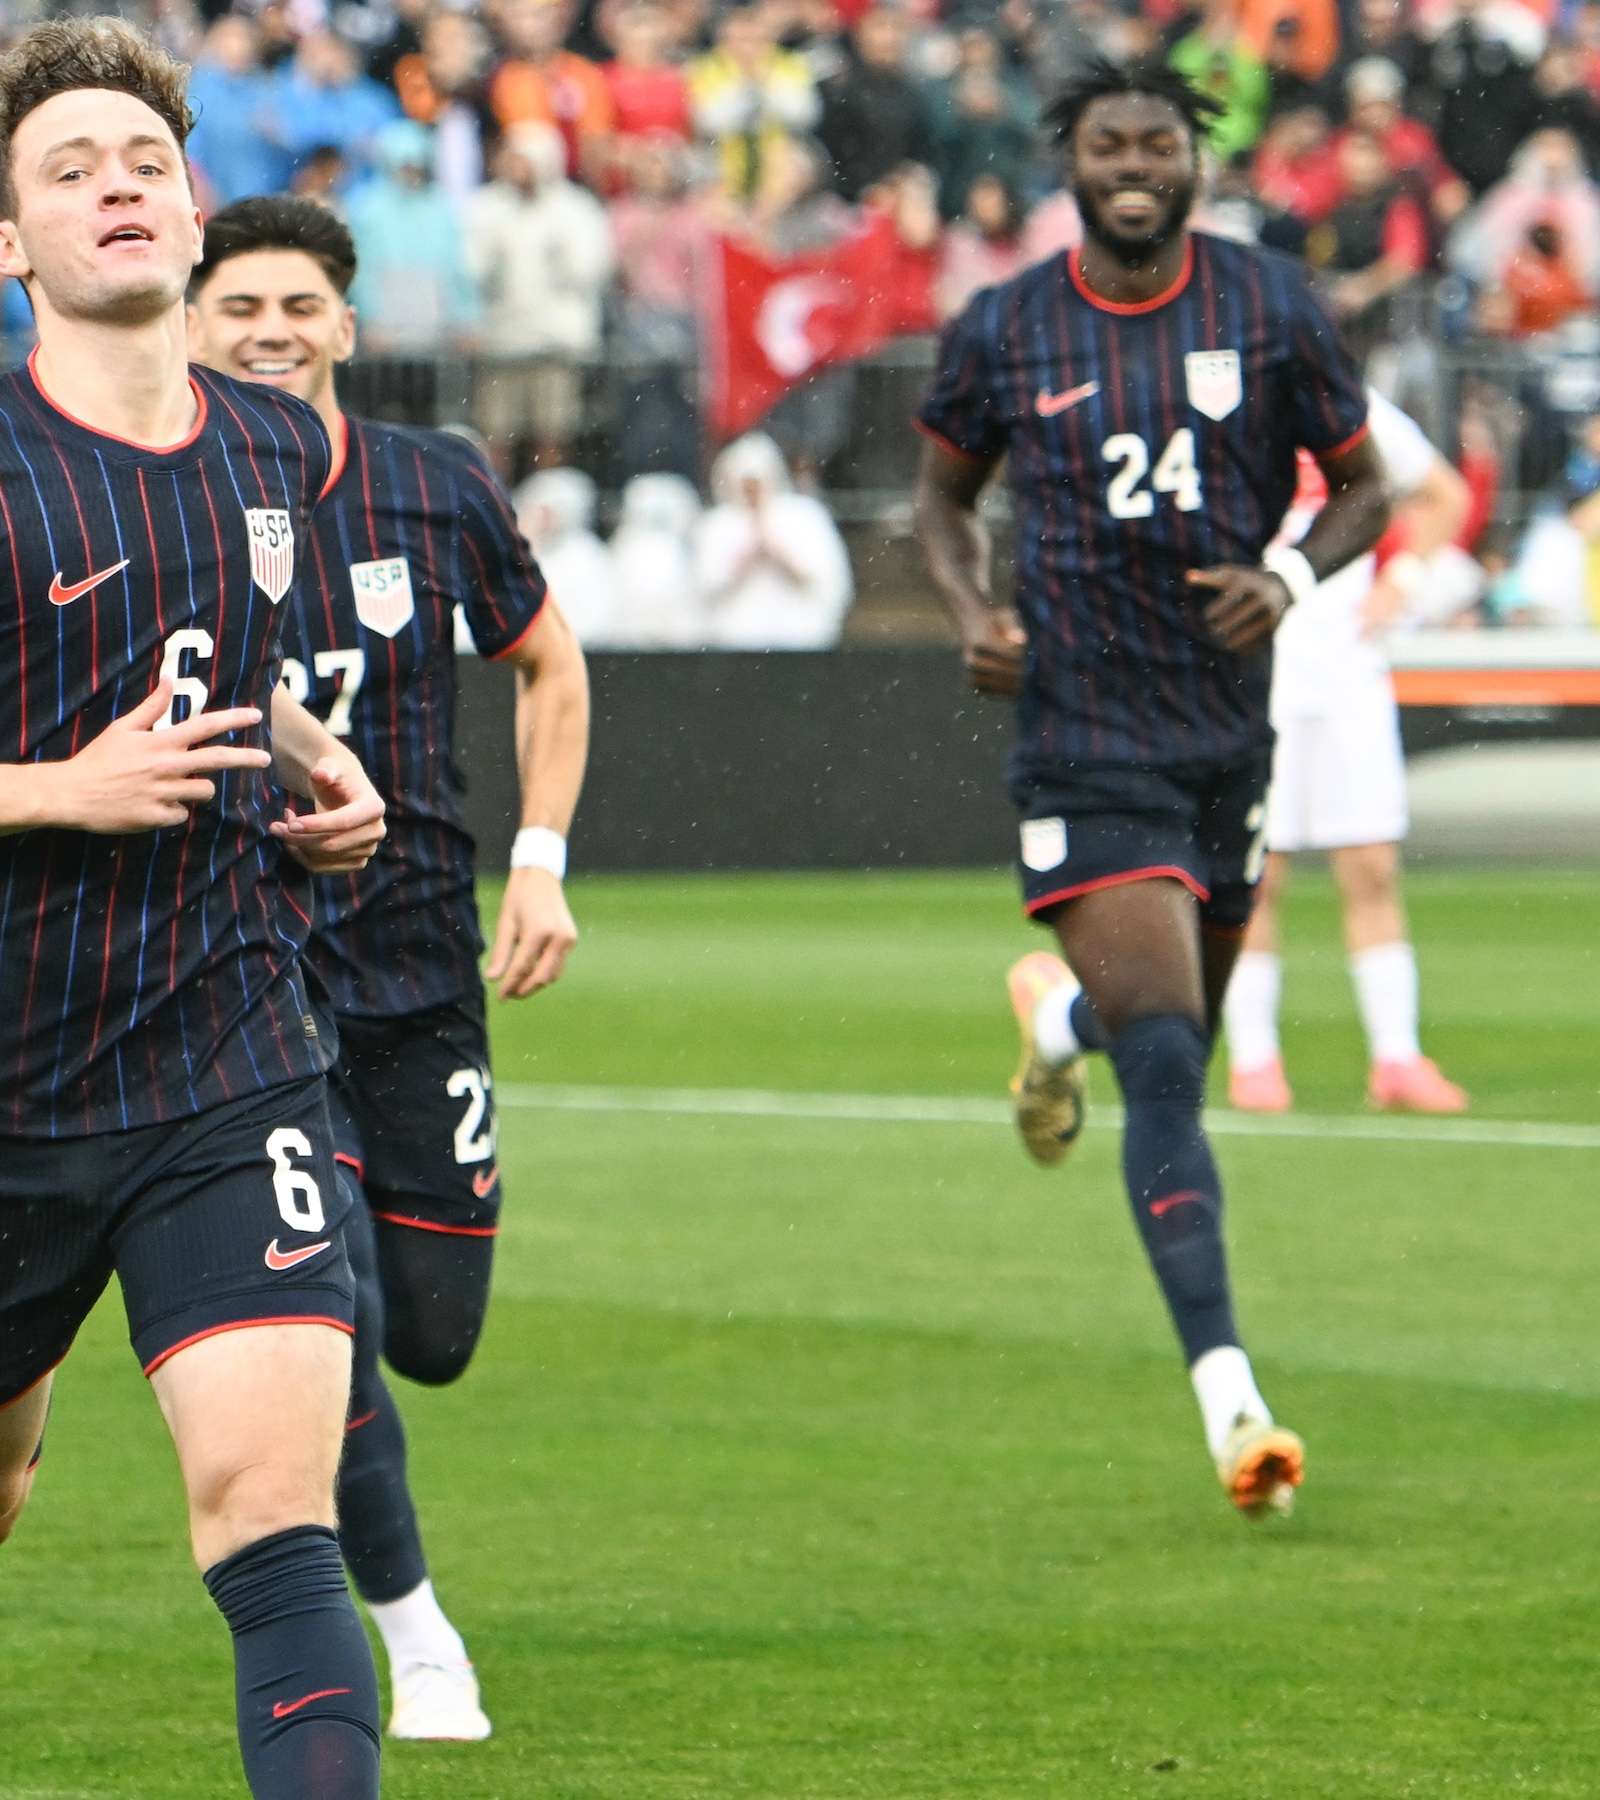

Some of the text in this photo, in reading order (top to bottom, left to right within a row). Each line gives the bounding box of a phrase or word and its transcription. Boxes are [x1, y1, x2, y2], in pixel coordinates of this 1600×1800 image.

[1101, 427, 1202, 518] 24
[251, 513, 290, 548] USA
[355, 563, 403, 593] USA
[153, 629, 214, 731] 6
[446, 1063, 498, 1165] 2
[266, 1128, 326, 1233] 6
